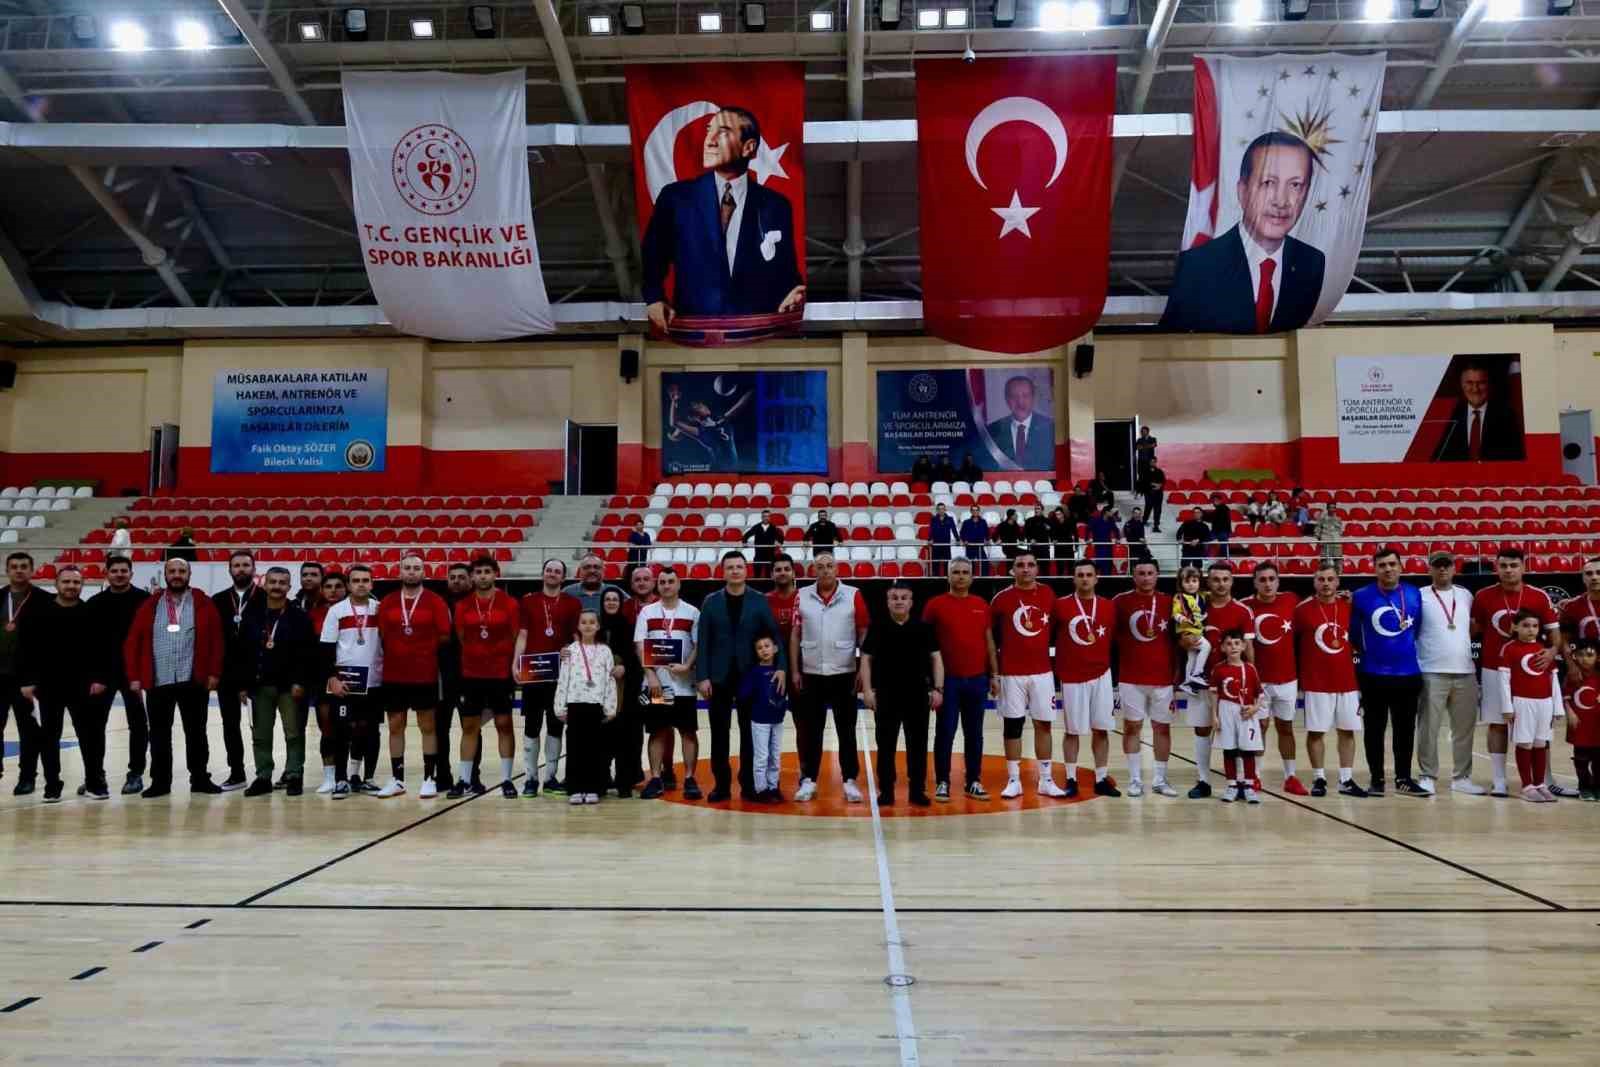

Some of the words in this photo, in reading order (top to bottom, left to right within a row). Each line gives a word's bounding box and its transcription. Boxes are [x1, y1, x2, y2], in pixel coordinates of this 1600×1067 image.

[364, 224, 399, 242] T.C.
[404, 224, 494, 247] GENÇLİK
[500, 224, 528, 242] VE
[368, 248, 418, 267] SPOR
[423, 246, 532, 268] BAKANLIĞI
[227, 372, 318, 384] MÜSABAKALARA
[321, 372, 368, 383] KATILAN
[236, 390, 279, 401] HAKEM,
[281, 388, 341, 400] ANTRENÖR
[343, 389, 358, 399] VE
[247, 405, 345, 417] SPORCULARIMIZA
[250, 443, 272, 454] Faik
[273, 443, 303, 455] Oktay
[304, 442, 336, 453] SÖZER
[263, 456, 296, 467] Bilecik
[298, 456, 324, 466] Valisi
[339, 705, 347, 717] 8
[1248, 728, 1255, 741] 7
